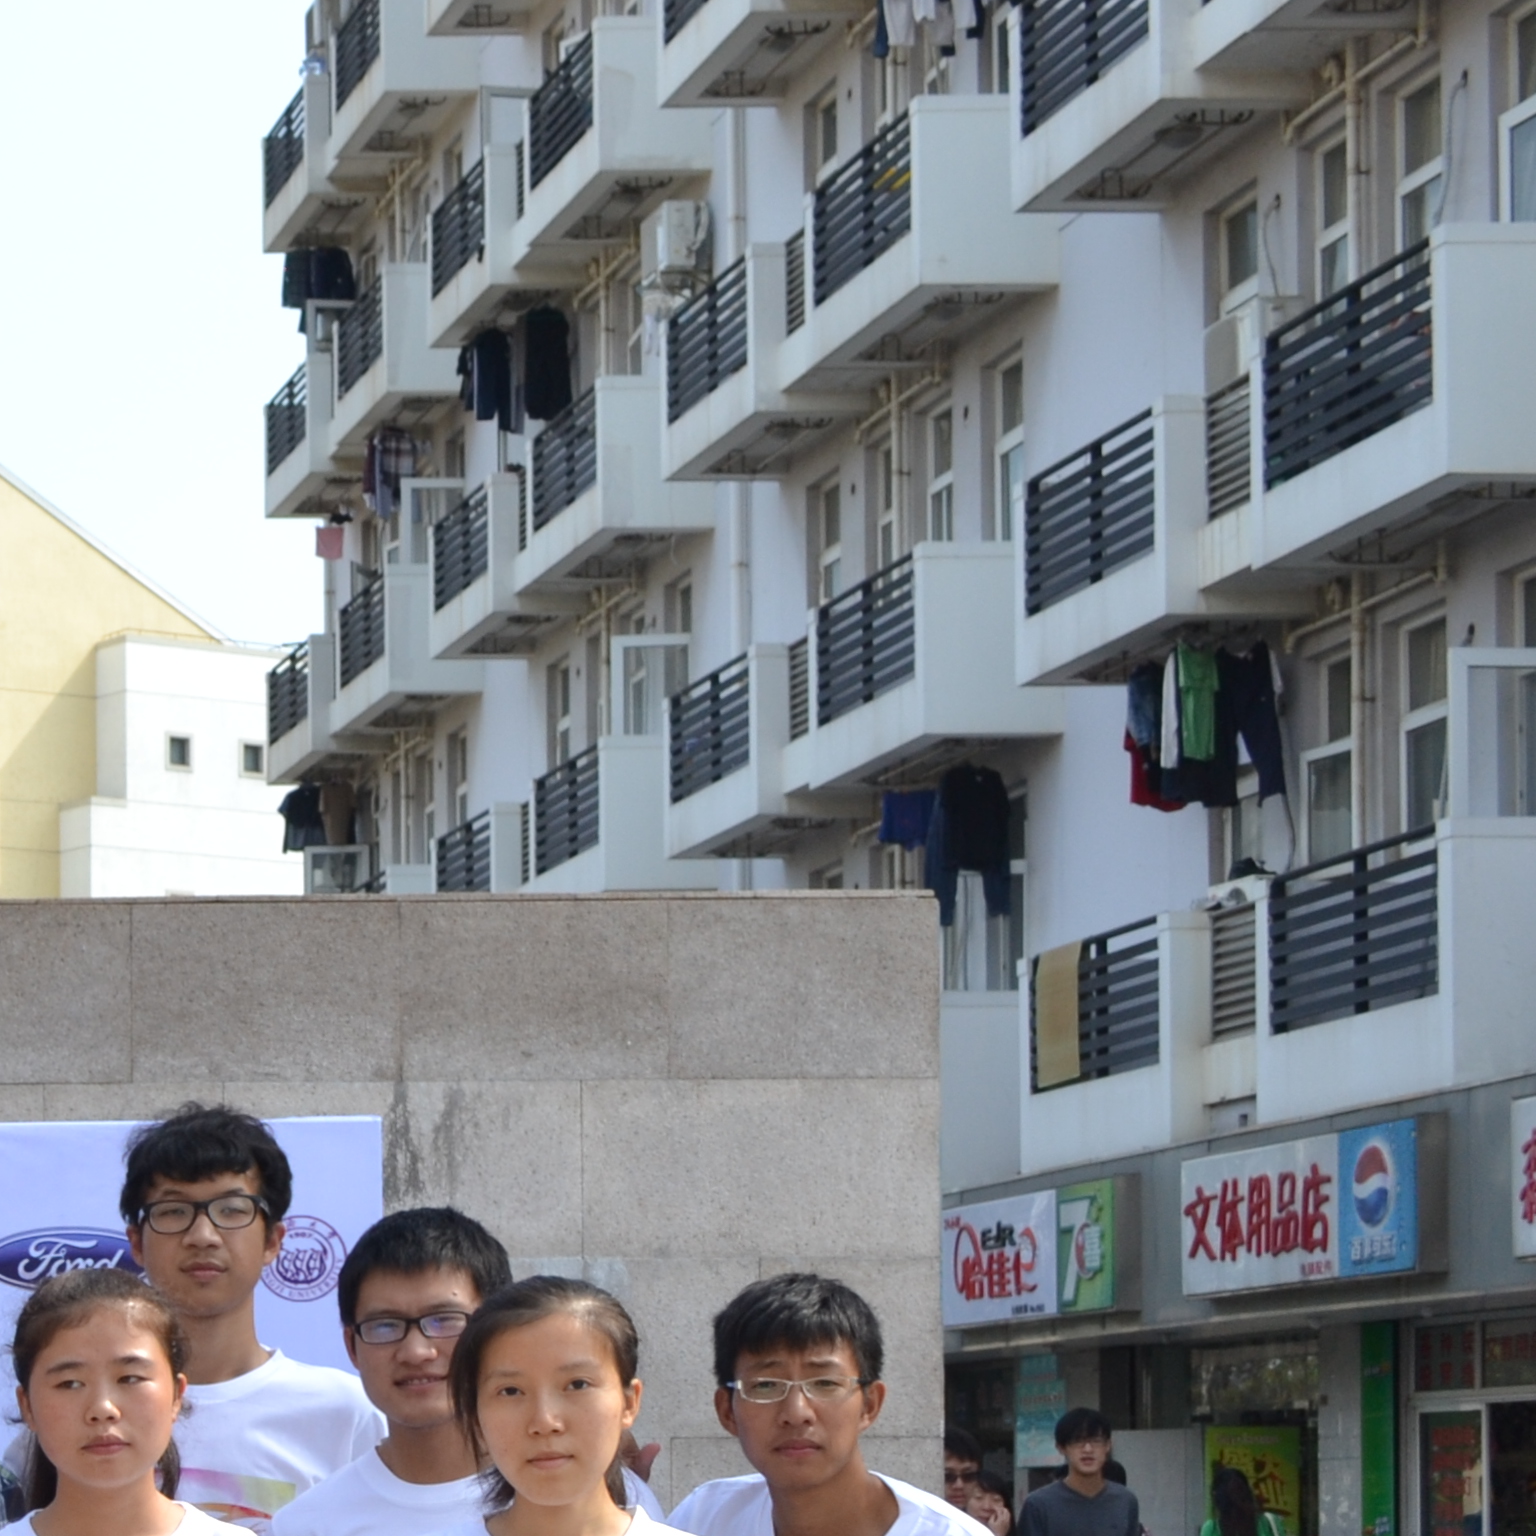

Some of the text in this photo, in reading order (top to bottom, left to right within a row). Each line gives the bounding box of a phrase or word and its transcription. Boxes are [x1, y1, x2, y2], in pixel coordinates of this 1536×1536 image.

[1184, 1162, 1332, 1263] 文体用品店
